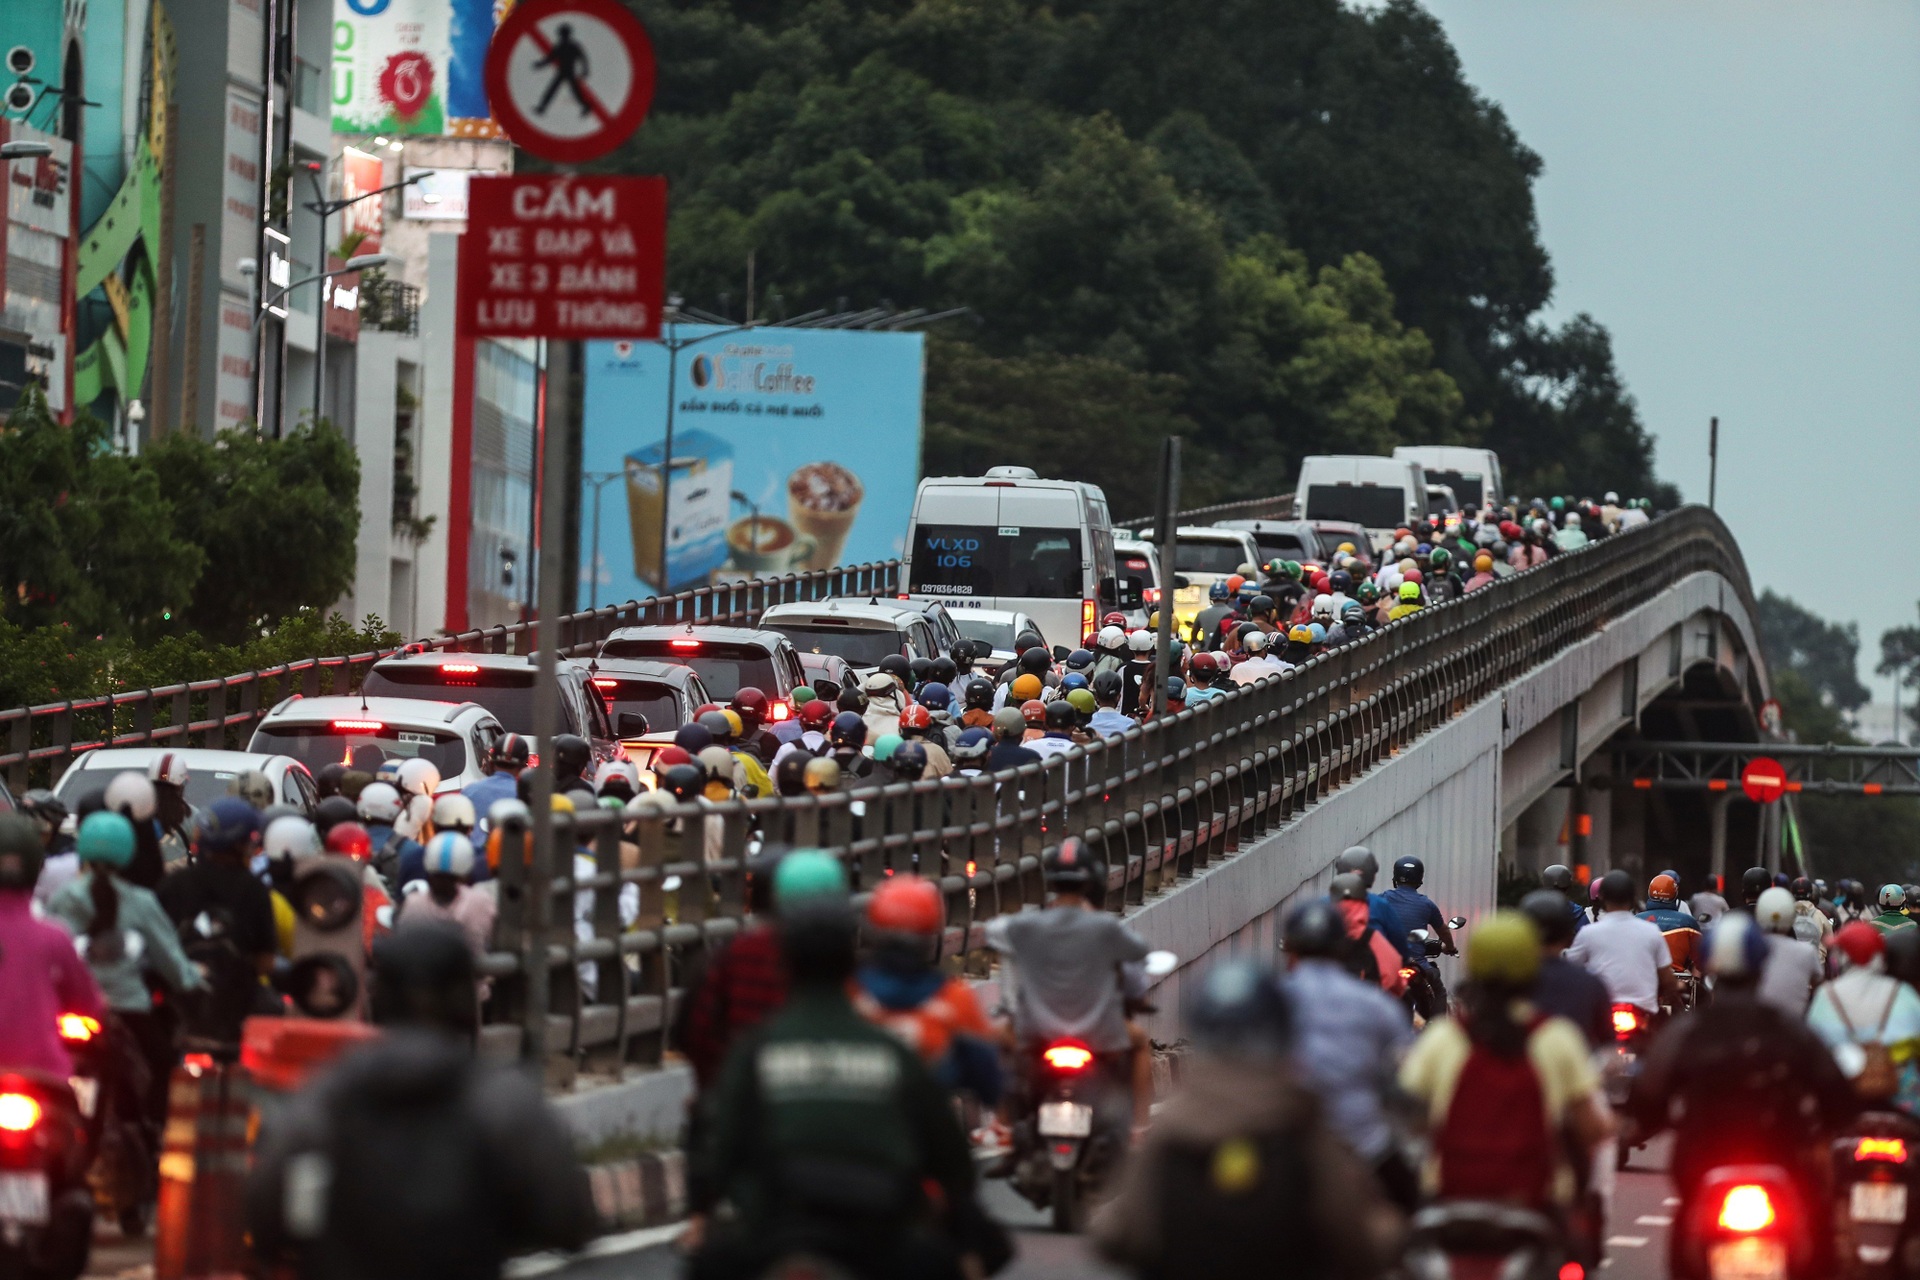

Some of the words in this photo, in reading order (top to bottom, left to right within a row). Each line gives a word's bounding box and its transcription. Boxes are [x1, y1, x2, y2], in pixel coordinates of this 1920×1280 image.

[512, 174, 616, 222] CẤM
[487, 226, 522, 256] XE
[489, 262, 524, 291] XE
[530, 263, 548, 292] 3
[558, 258, 637, 293] BÁNH
[754, 362, 815, 392] Coffee
[927, 538, 980, 551] VLXD
[937, 555, 972, 568] 106
[921, 584, 973, 595] 0978364828
